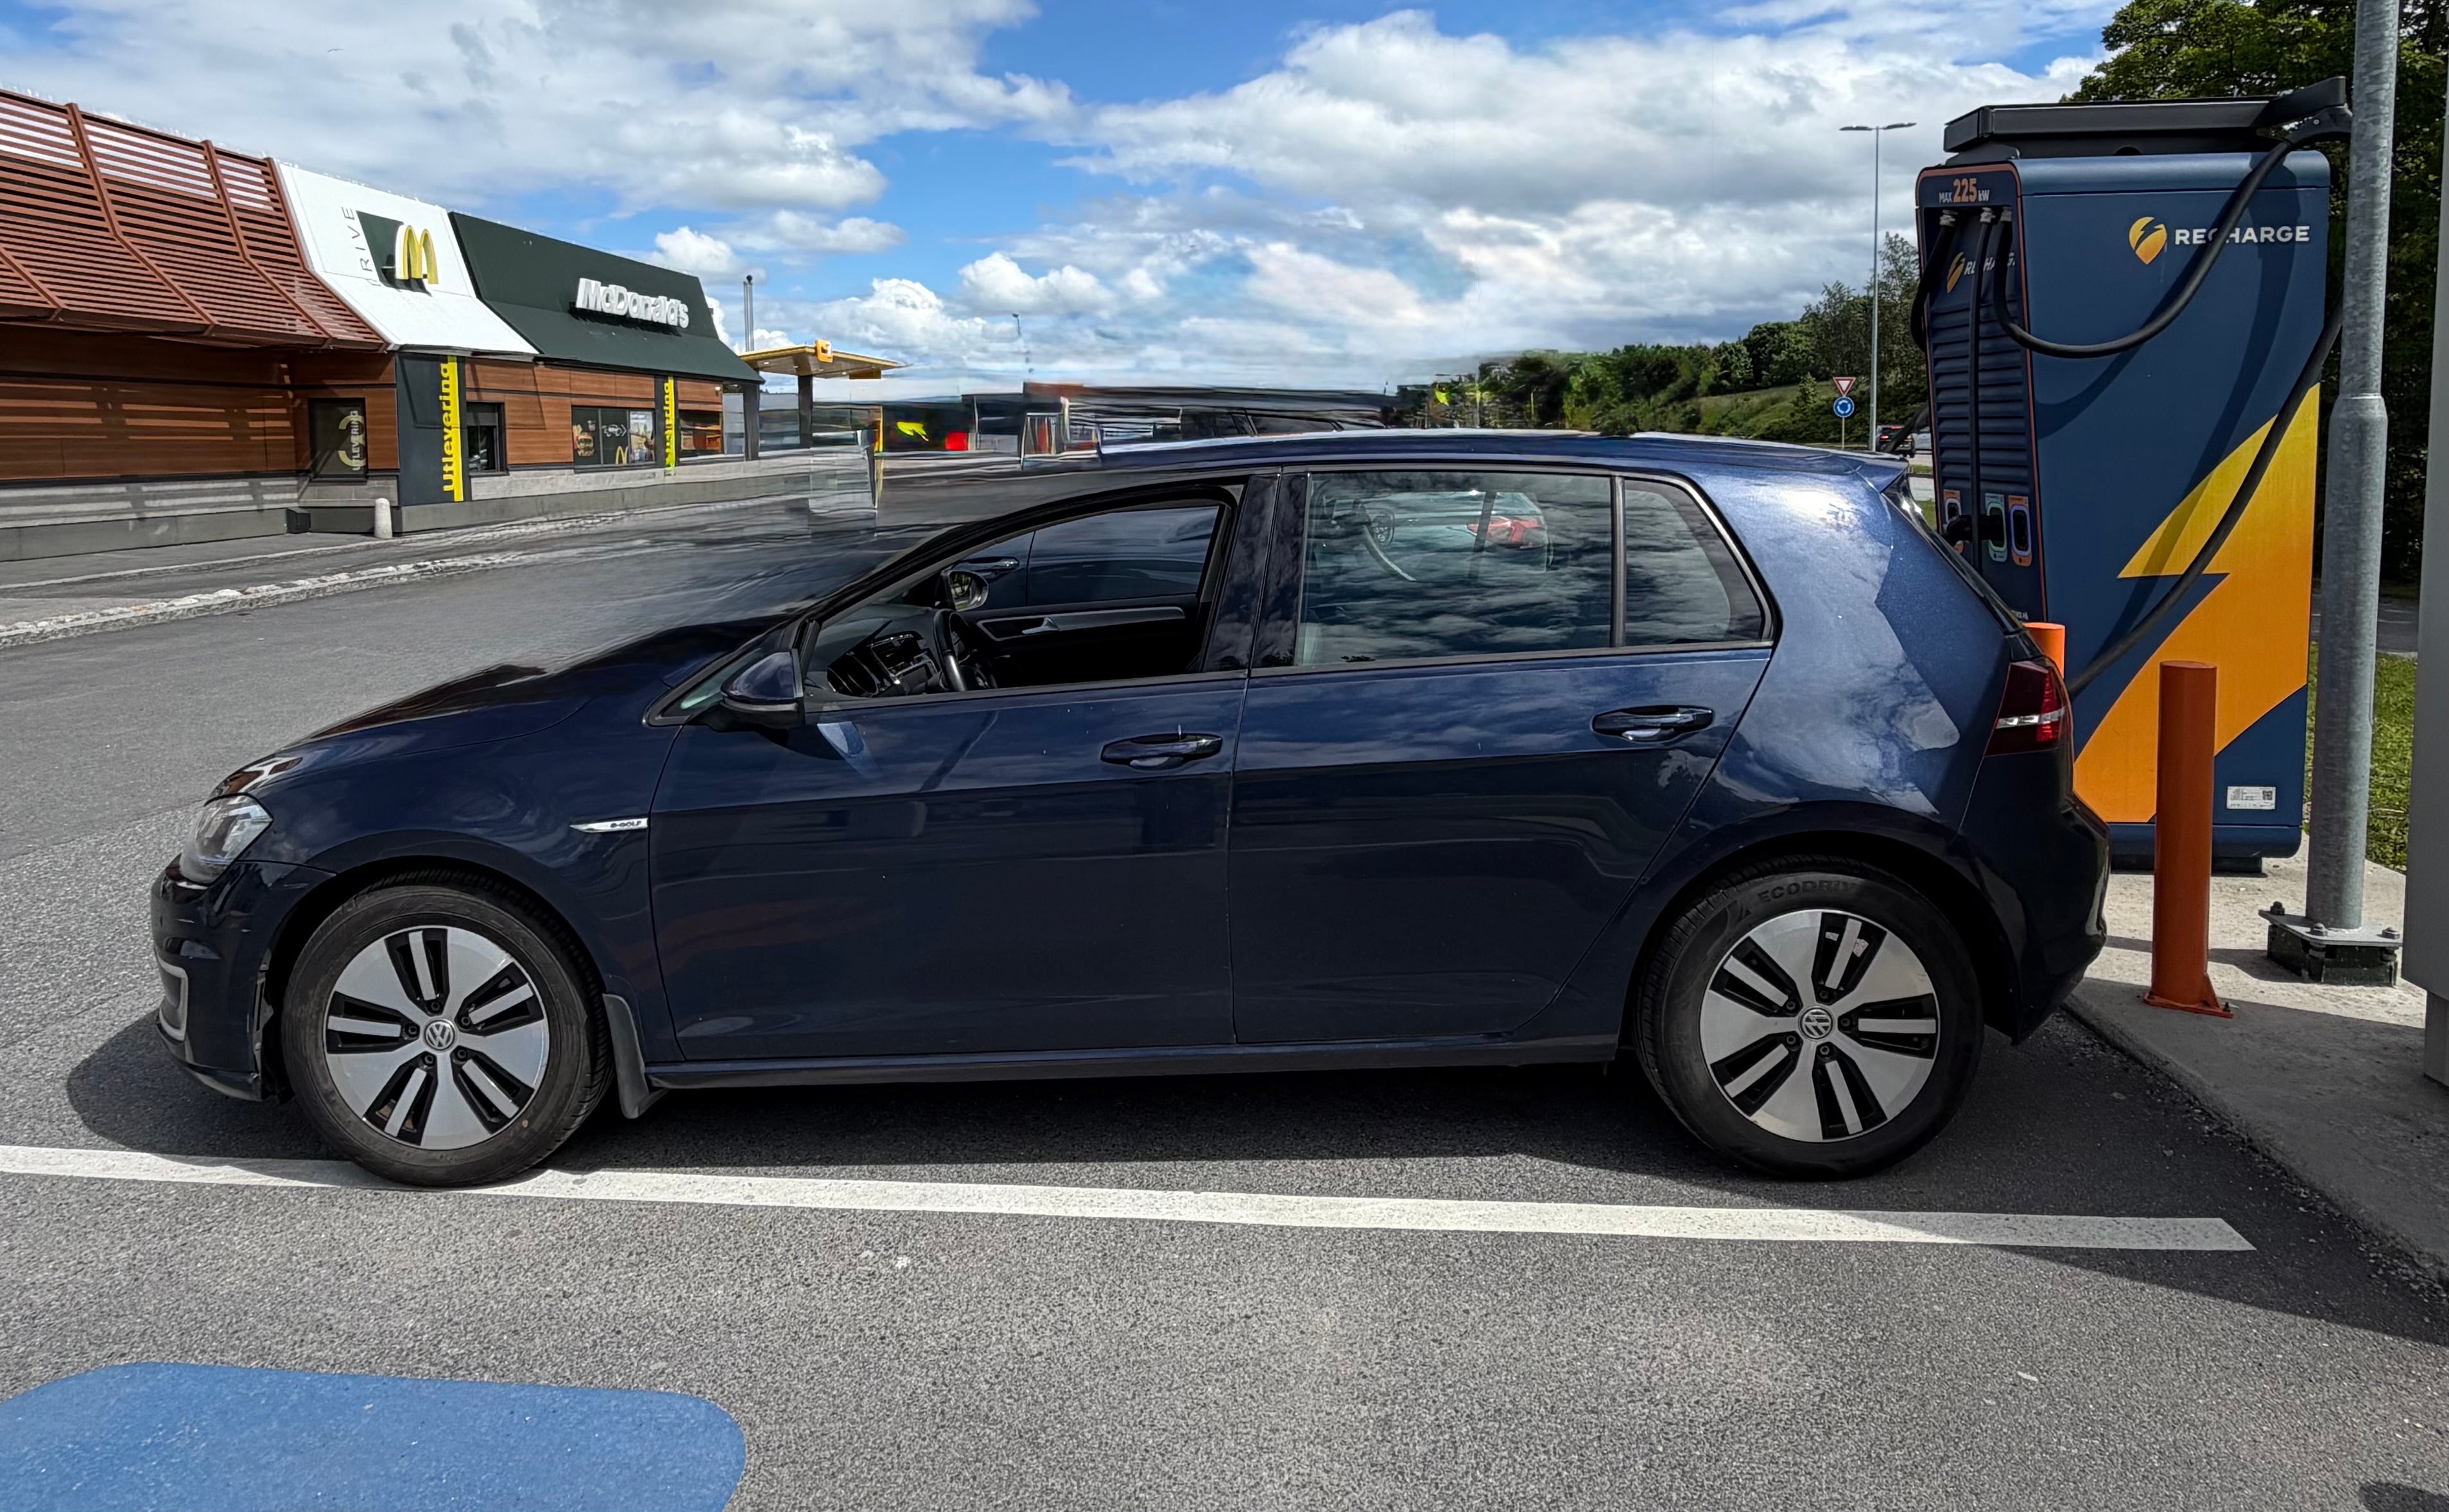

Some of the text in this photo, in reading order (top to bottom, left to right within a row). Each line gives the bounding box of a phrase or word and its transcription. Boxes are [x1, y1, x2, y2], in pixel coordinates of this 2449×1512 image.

[1939, 192, 1952, 203] MAX
[1953, 178, 1977, 203] 225
[576, 277, 689, 329] McDonald's
